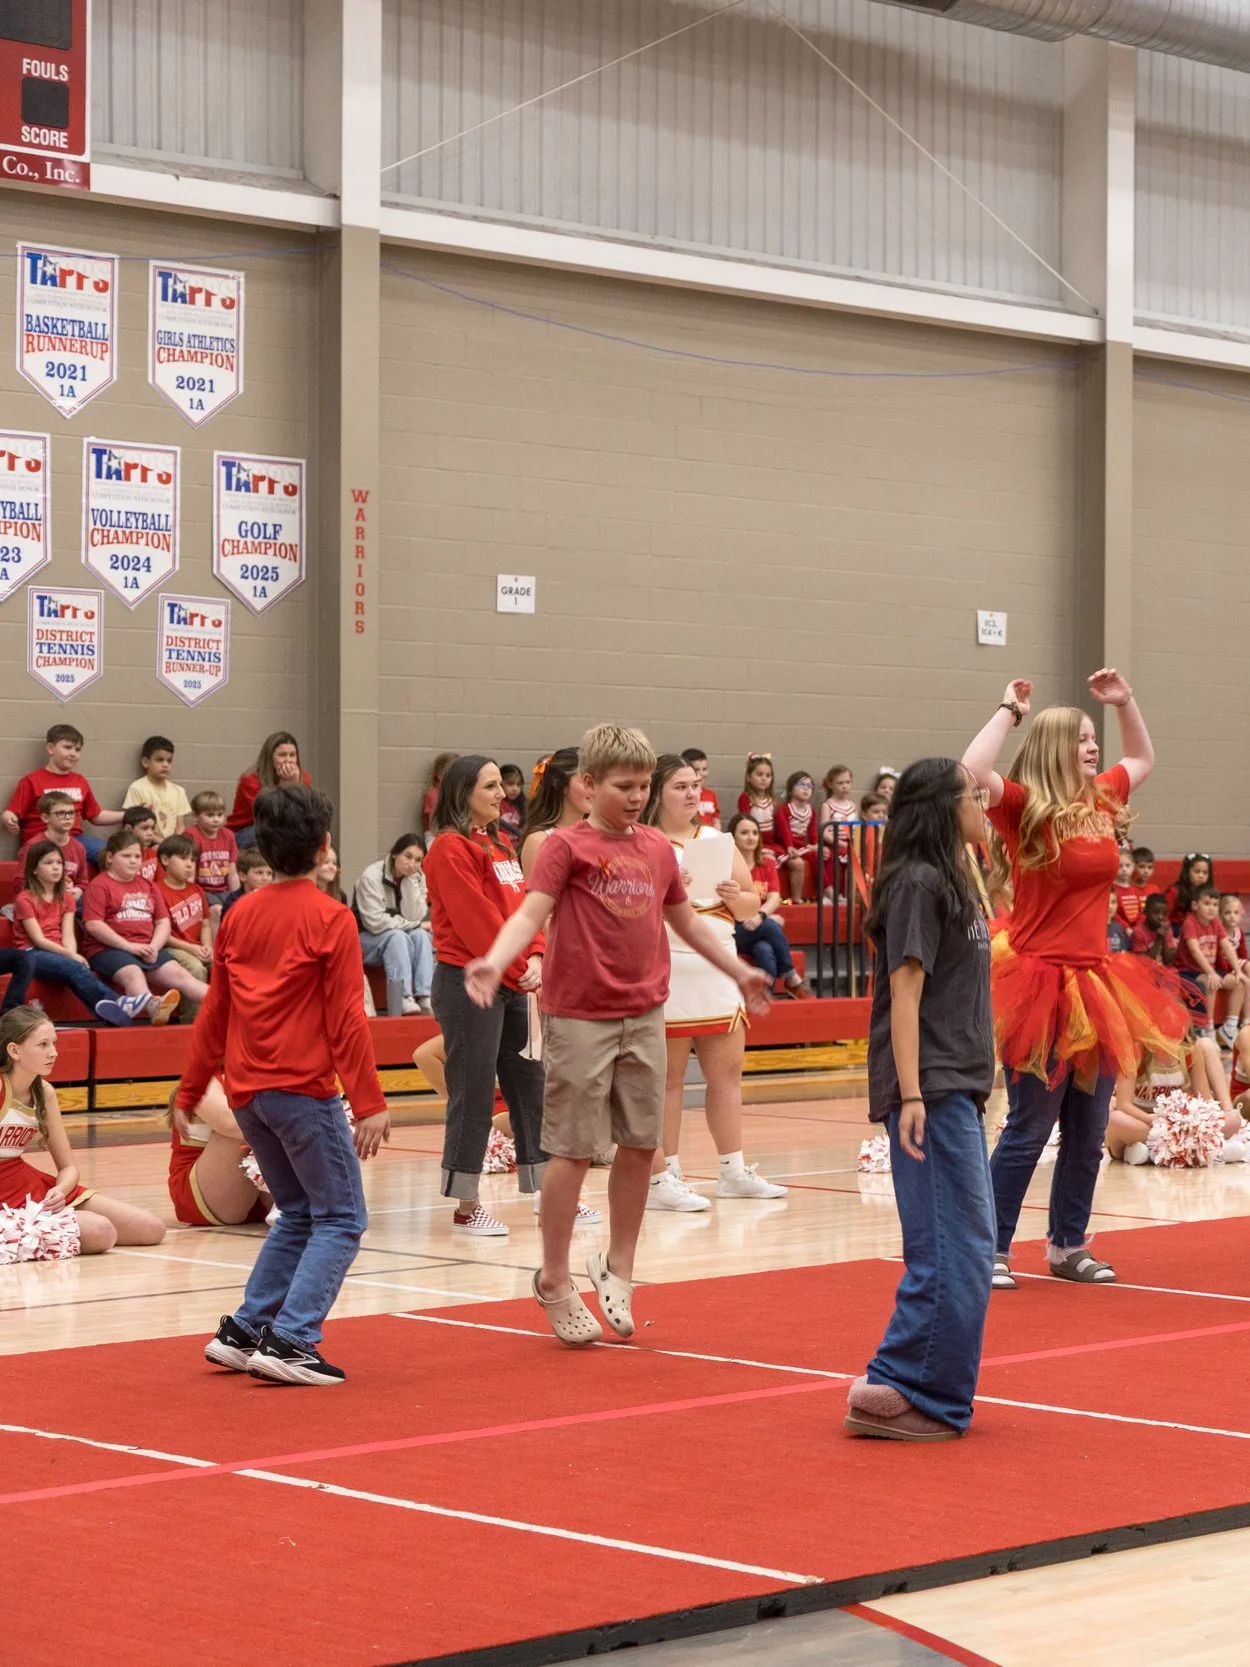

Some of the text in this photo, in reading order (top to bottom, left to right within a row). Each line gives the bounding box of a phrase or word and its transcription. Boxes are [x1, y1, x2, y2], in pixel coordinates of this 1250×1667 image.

[22, 58, 69, 82] FOULS
[21, 126, 68, 148] SCORE
[2, 156, 80, 182] Co., Inc.
[25, 314, 108, 341] BASKETBALL
[25, 334, 108, 361] RUNNERUP
[157, 330, 235, 353] GIRLS ATHLETICS
[157, 347, 234, 372] CHAMPION
[46, 362, 87, 381] 2021
[59, 385, 76, 397] 1A
[176, 376, 215, 393] 2021
[189, 398, 204, 410] 1A
[91, 508, 171, 532] VOLLEYBALL
[238, 520, 282, 540] GOLF
[90, 527, 170, 552] CHAMPION
[221, 538, 298, 563] CHAMPION
[110, 554, 151, 572] 2024
[351, 489, 369, 633] WARRIORS
[240, 564, 279, 582] 2025
[123, 577, 139, 589] 1A
[252, 586, 267, 598] 1A
[501, 586, 531, 596] GRADE
[36, 629, 95, 643] DISTRICT
[166, 635, 221, 650] DISTRICT
[36, 642, 95, 656] TENNIS
[165, 648, 221, 663] TENNIS
[36, 656, 95, 670] CHAMPION
[165, 662, 221, 676] RUNNER-UP
[56, 674, 75, 683] 2025
[184, 680, 201, 689] 2025
[588, 871, 654, 896] Warriors
